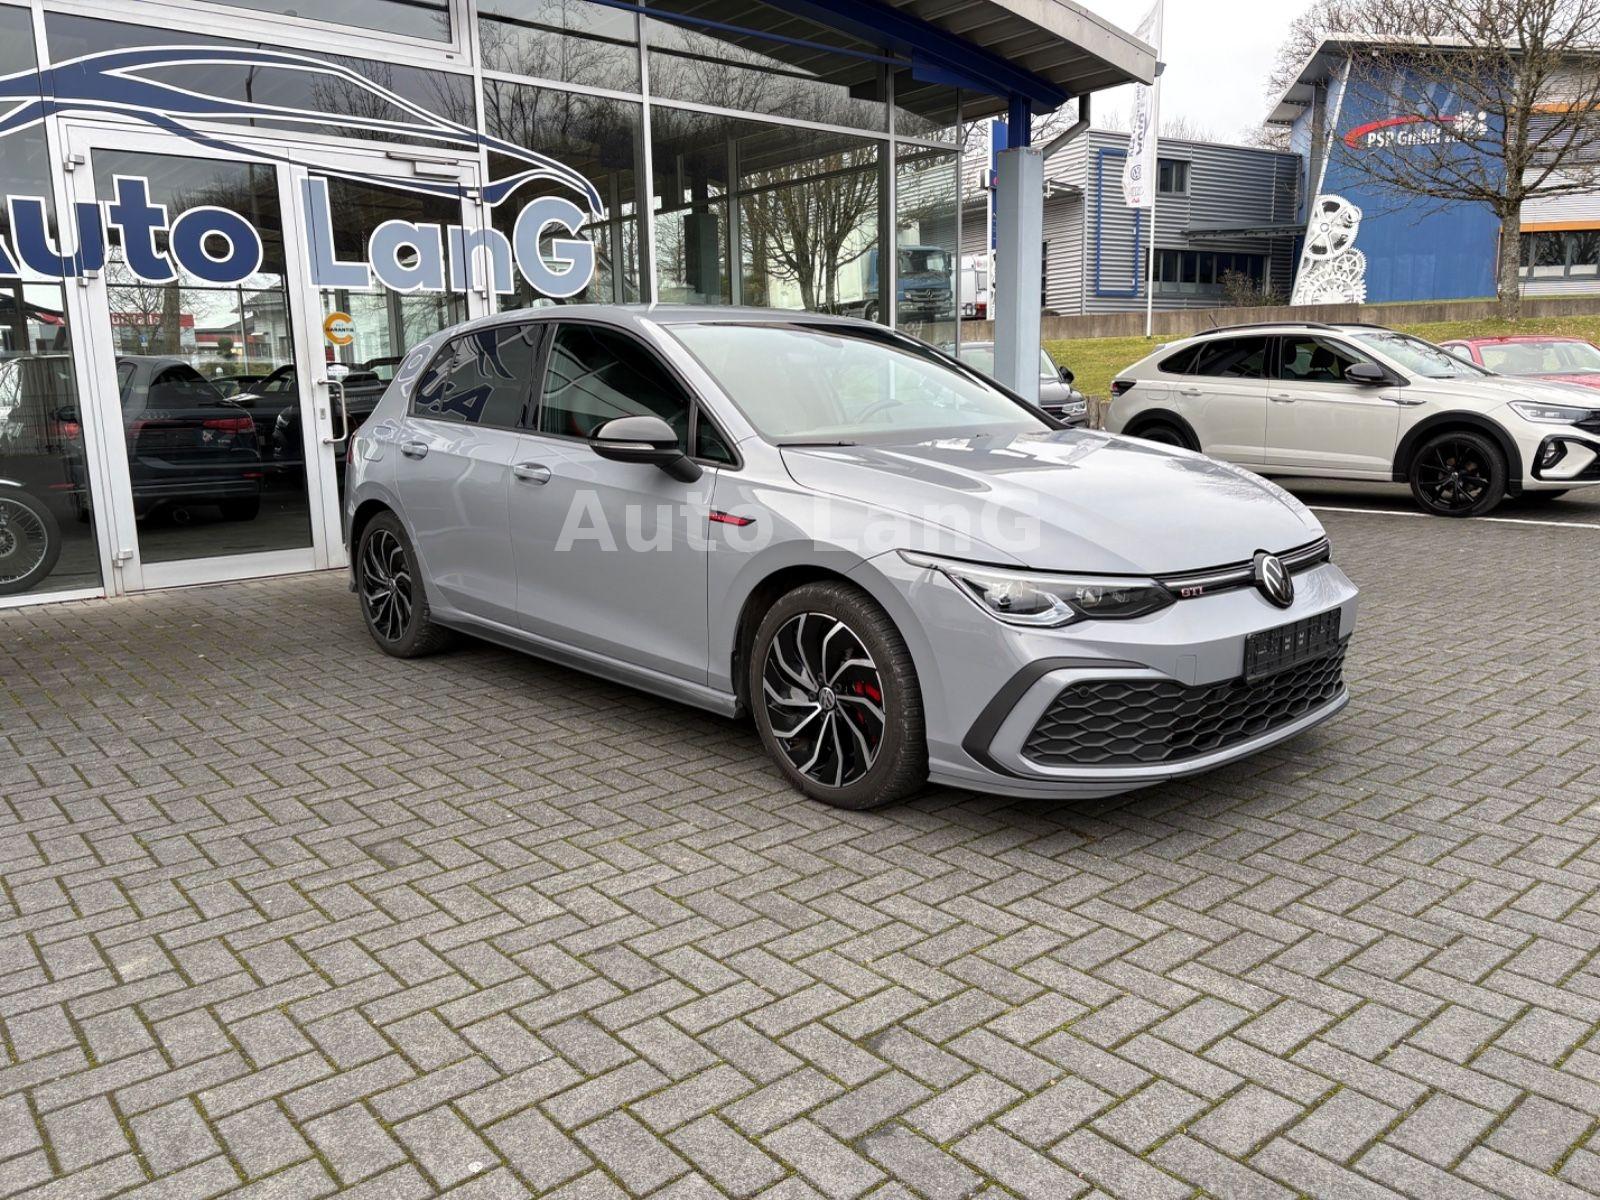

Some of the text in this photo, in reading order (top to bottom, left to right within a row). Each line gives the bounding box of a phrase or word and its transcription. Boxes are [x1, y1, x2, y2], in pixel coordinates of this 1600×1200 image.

[1367, 131, 1394, 148] PSP
[1397, 128, 1441, 146] GmbH
[0, 174, 596, 299] uto LanG
[1181, 585, 1204, 597] GTI
